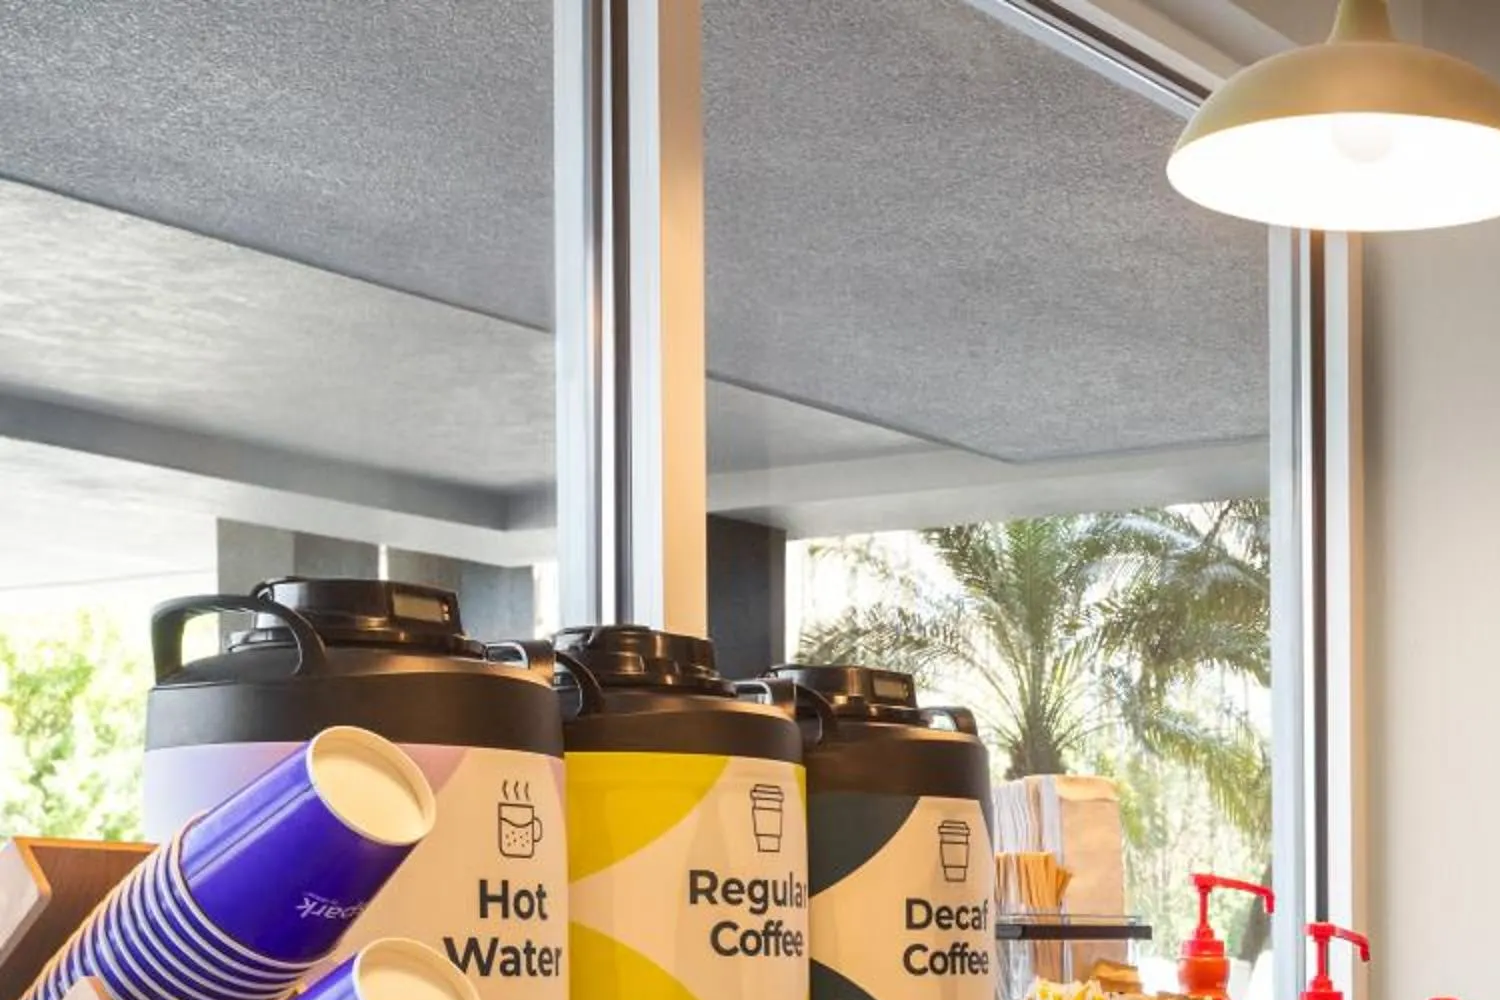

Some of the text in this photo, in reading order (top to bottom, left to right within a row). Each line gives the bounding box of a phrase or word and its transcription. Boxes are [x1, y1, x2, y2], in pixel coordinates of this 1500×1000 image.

[478, 879, 548, 921] Hot
[688, 868, 807, 915] Regular
[904, 897, 989, 932] Decaf
[442, 936, 563, 978] Water
[710, 919, 804, 957] Coffee
[903, 942, 989, 976] Coffee
